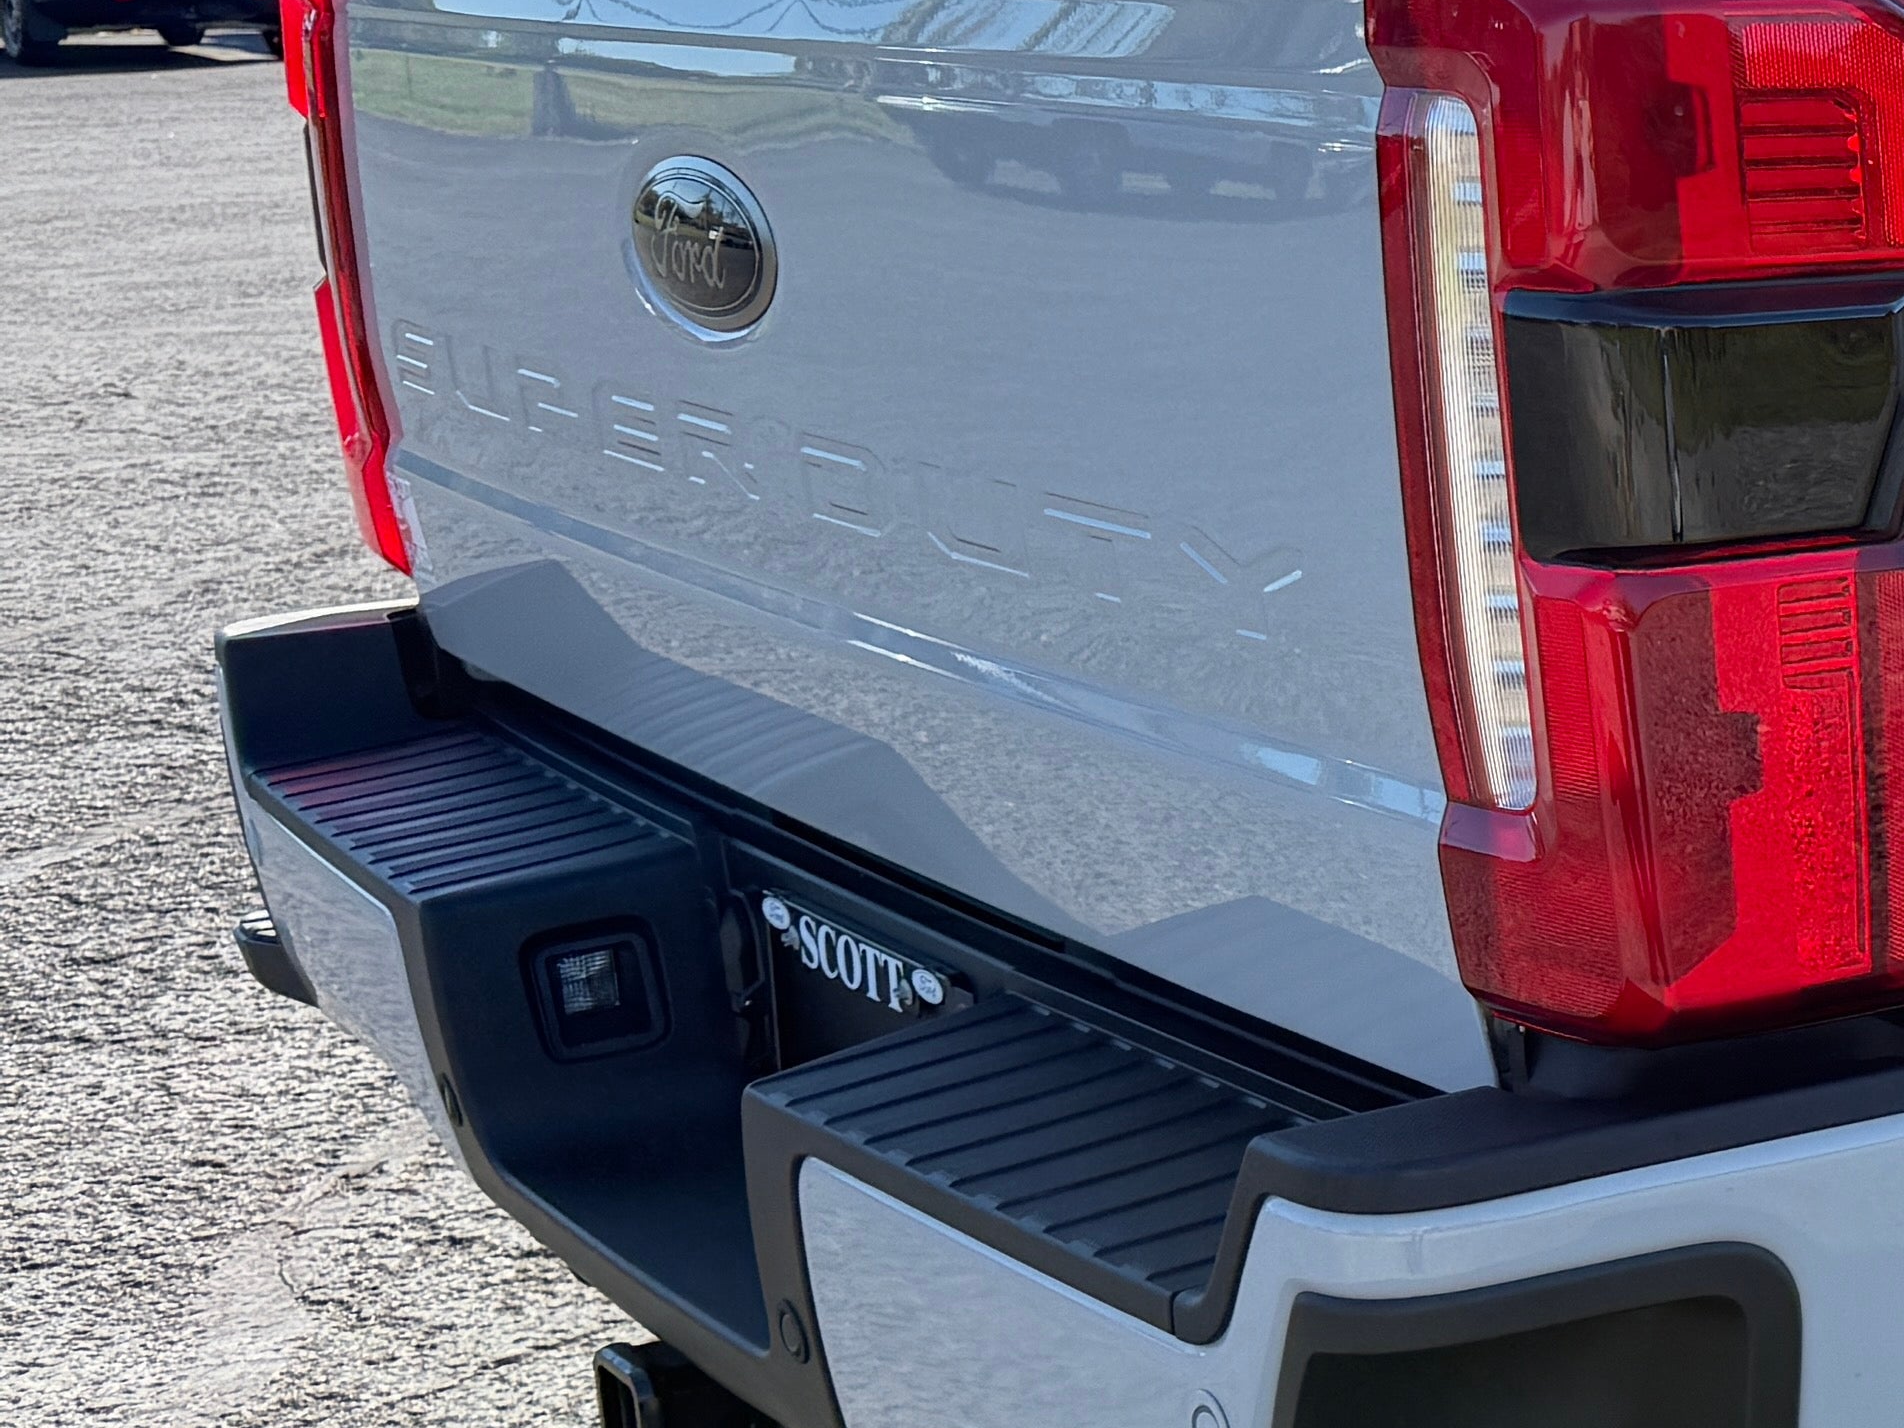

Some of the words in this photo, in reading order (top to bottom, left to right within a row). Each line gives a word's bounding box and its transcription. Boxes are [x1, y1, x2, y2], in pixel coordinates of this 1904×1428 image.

[651, 189, 726, 290] Ford
[394, 319, 760, 501] SUPER
[799, 429, 1304, 641] DUTY
[799, 915, 904, 1013] SCOTT
